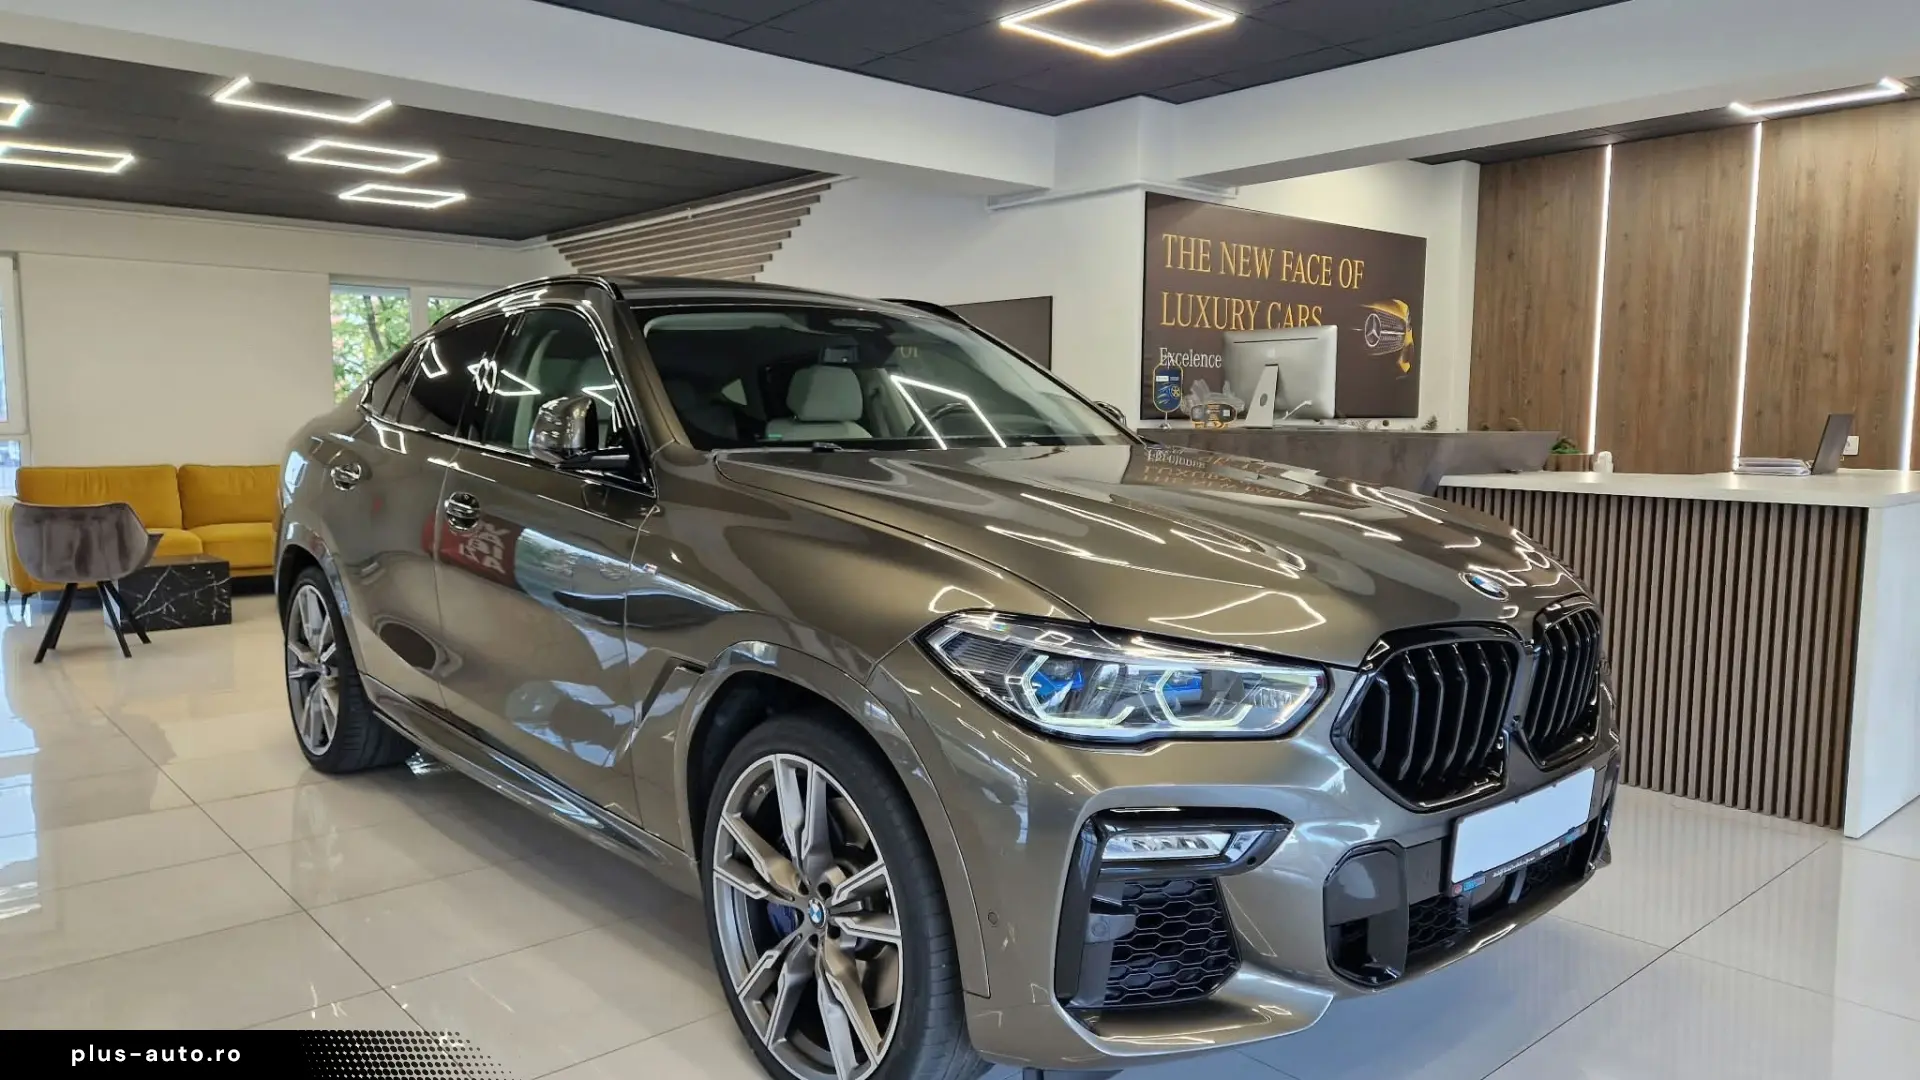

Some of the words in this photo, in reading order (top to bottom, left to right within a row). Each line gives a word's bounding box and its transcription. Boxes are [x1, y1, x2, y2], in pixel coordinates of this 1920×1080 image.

[1161, 233, 1211, 273] THE
[1220, 241, 1274, 281] NEW
[1280, 249, 1333, 287] FACE
[1338, 258, 1365, 289] OF
[1160, 291, 1261, 331] LUXURY
[1267, 301, 1323, 329] CARS
[1159, 347, 1222, 368] Excelence
